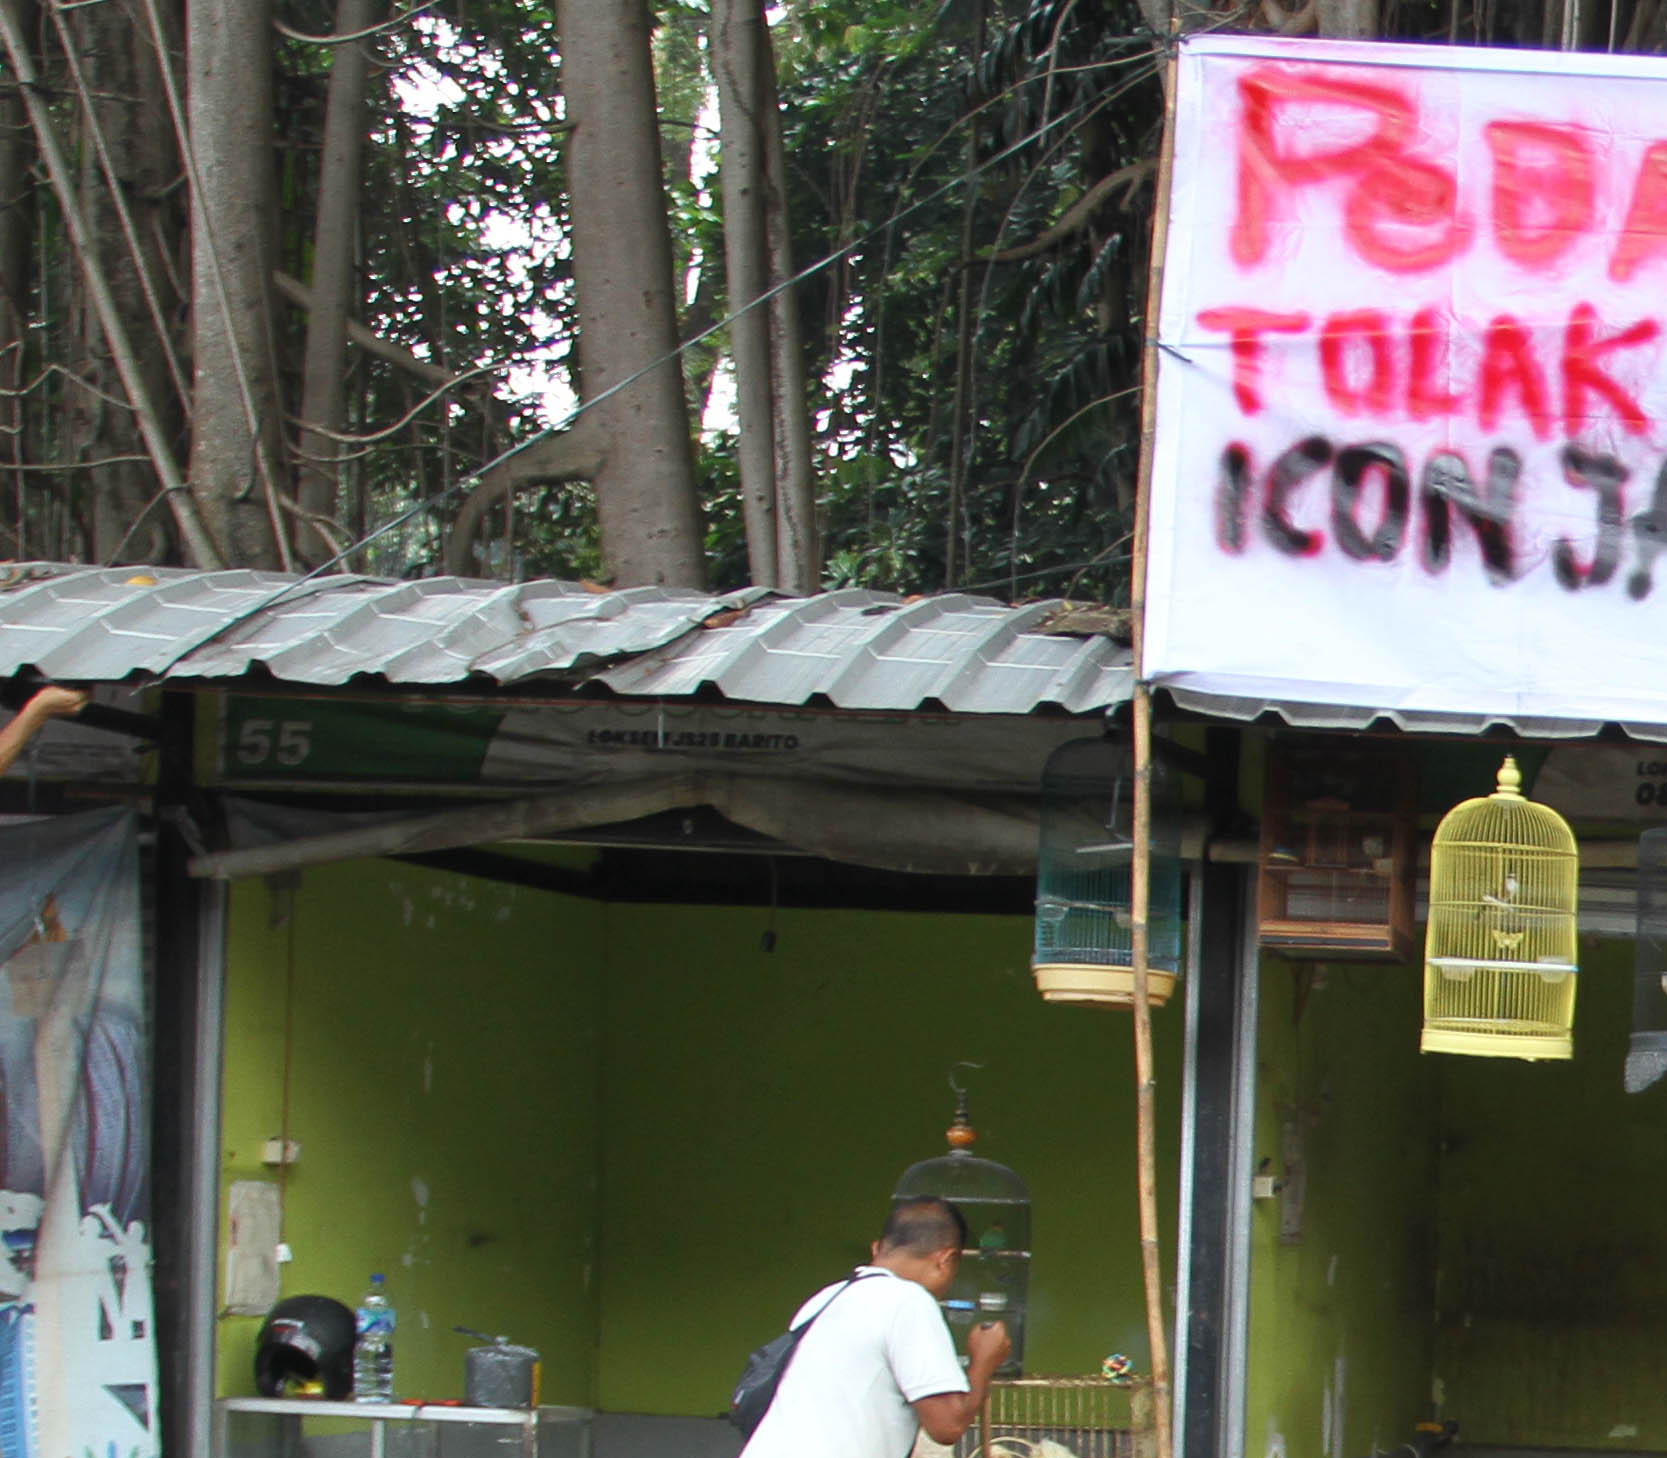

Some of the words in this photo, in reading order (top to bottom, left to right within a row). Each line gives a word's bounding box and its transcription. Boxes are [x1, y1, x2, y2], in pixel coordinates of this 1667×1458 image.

[1197, 304, 1660, 440] TOLAK
[1216, 434, 1524, 586] ICON
[237, 719, 313, 765] 55
[723, 733, 798, 749] BARITO
